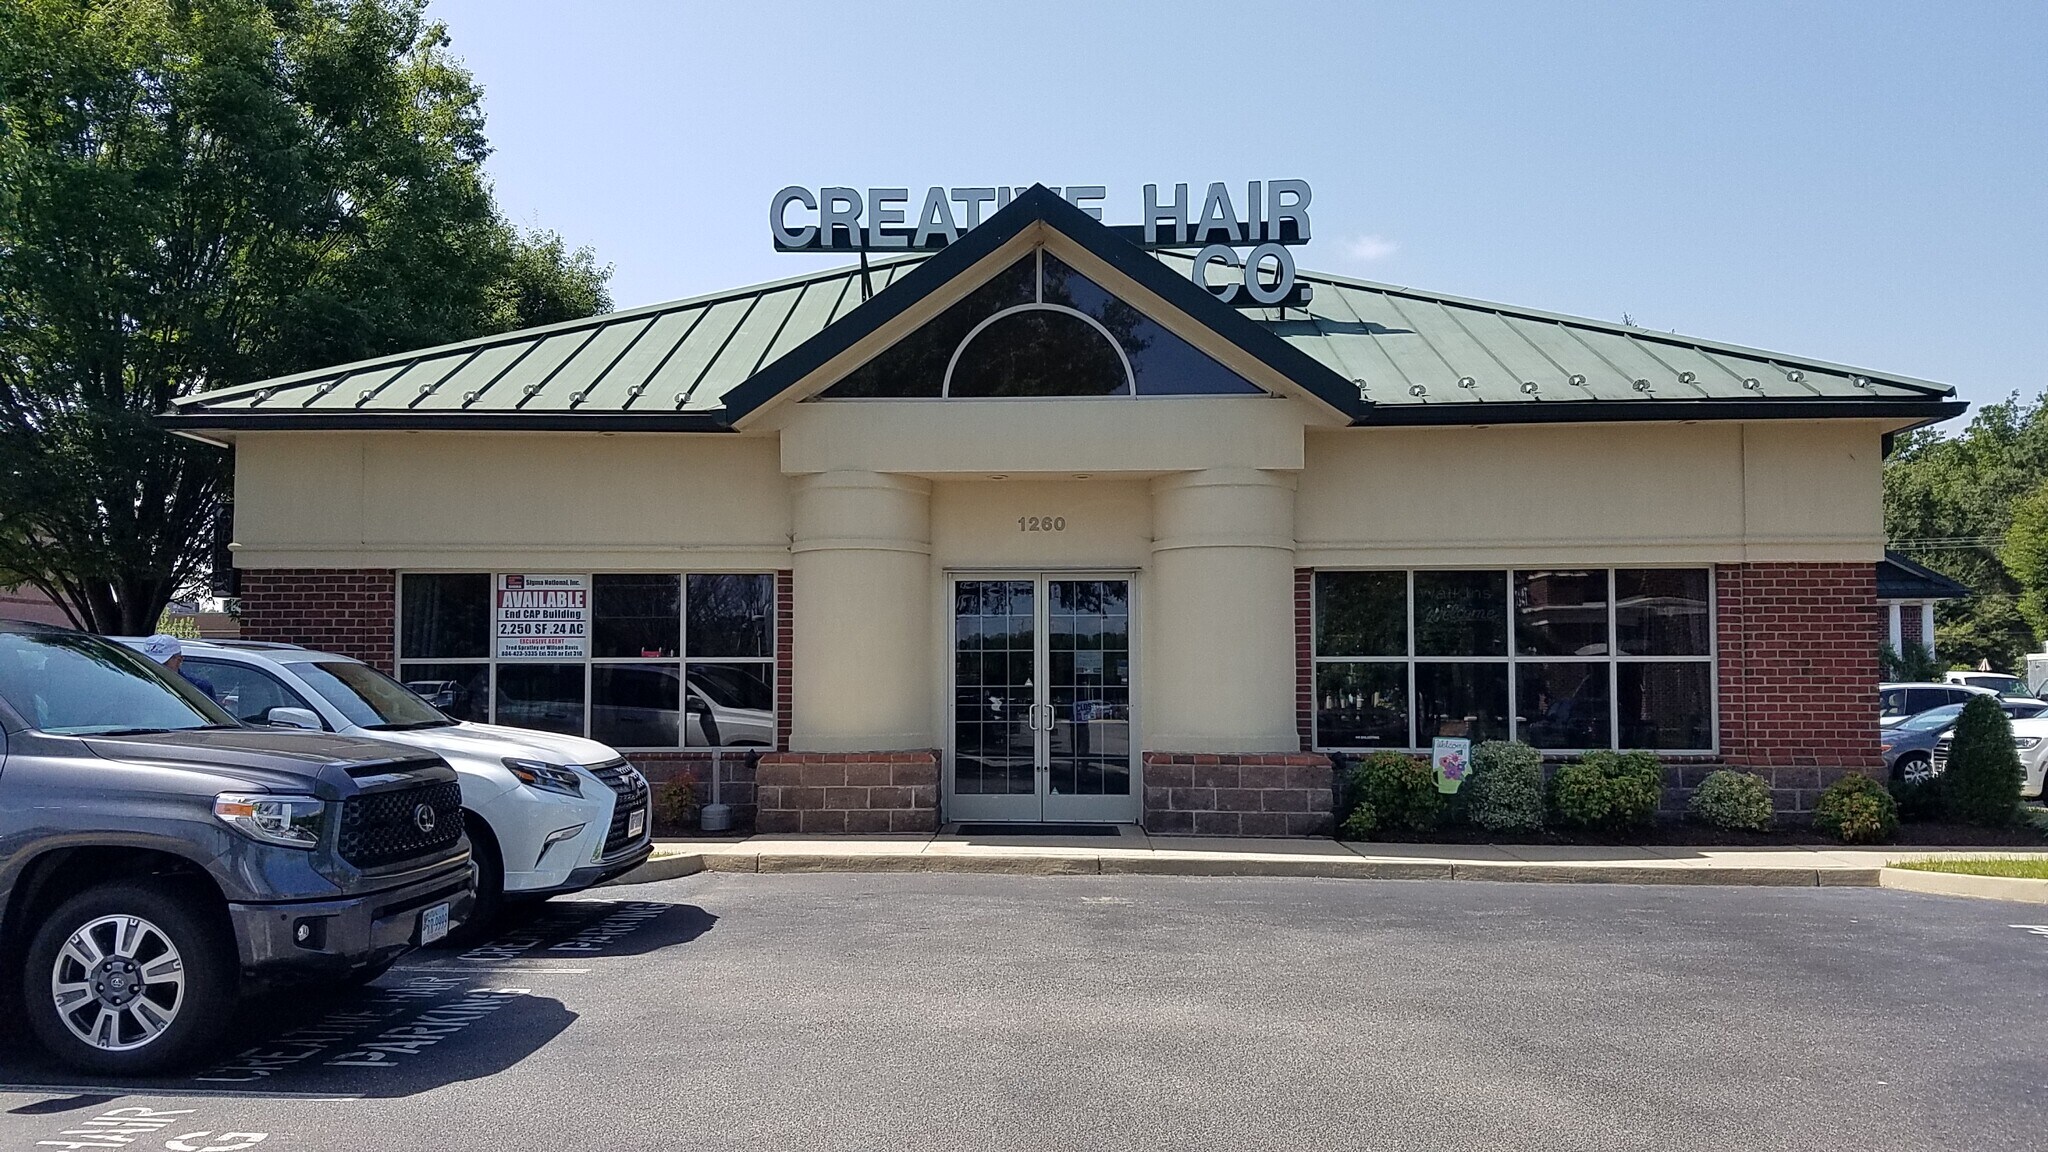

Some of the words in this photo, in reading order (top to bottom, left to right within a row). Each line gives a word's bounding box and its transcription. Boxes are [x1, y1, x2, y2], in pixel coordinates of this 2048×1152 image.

[770, 185, 1106, 249] CREAT
[1143, 179, 1313, 246] HAIR
[1192, 243, 1313, 304] CO.
[1018, 516, 1066, 532] 1260
[502, 591, 584, 608] AVAILABLE
[505, 609, 521, 619] End
[523, 609, 541, 619] CAP
[542, 609, 581, 620] Building
[500, 623, 532, 635] 2,250
[534, 623, 548, 635] SF
[549, 623, 567, 635] .24
[569, 623, 584, 635] AC
[321, 987, 531, 1068] PARKING
